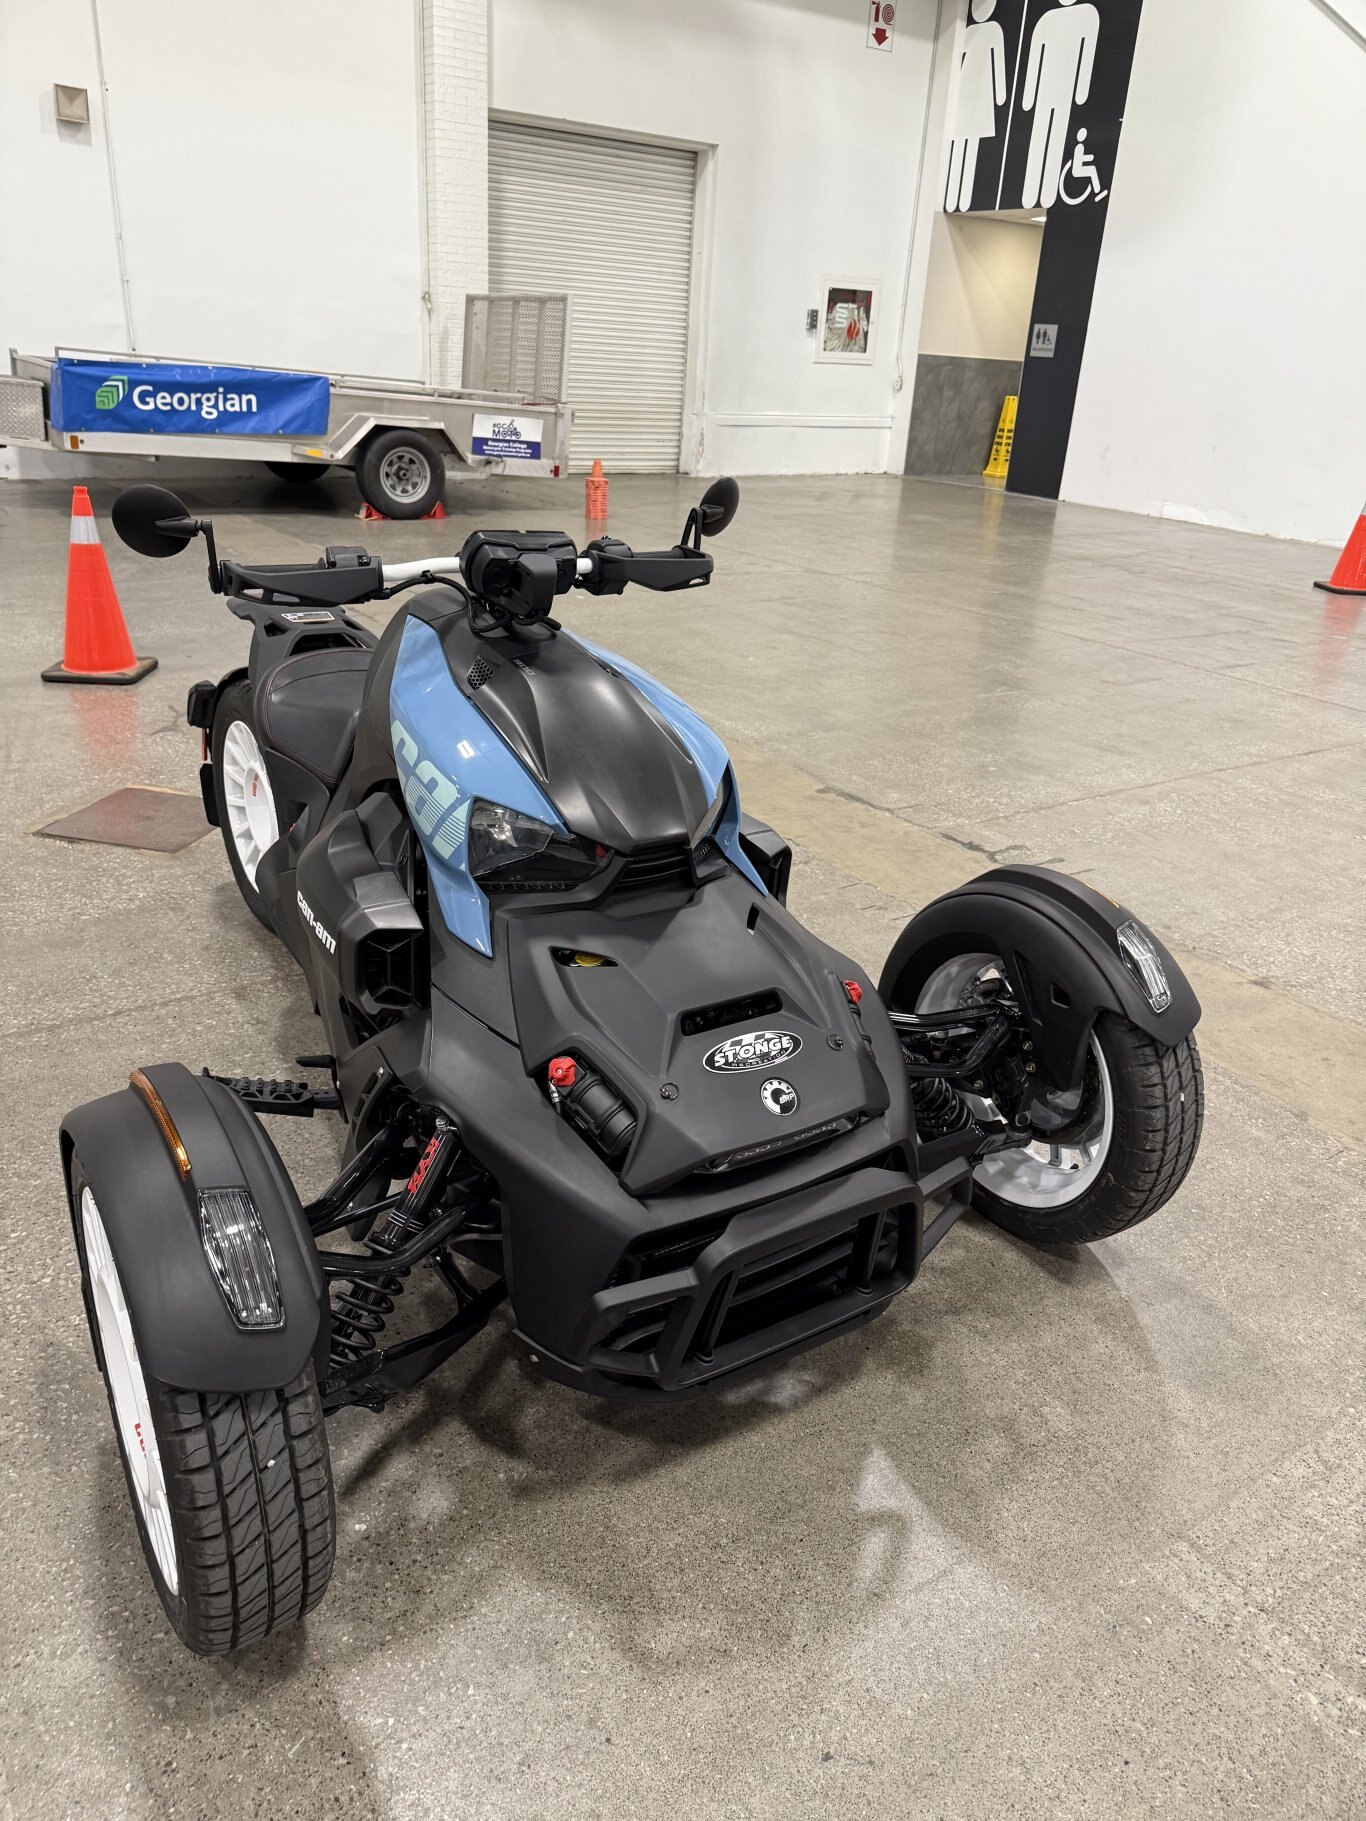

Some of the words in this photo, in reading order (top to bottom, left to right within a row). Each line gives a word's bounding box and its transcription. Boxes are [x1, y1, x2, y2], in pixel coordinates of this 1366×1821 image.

[132, 385, 257, 419] Georgian
[492, 429, 522, 440] MOTO
[780, 1093, 795, 1105] BRP
